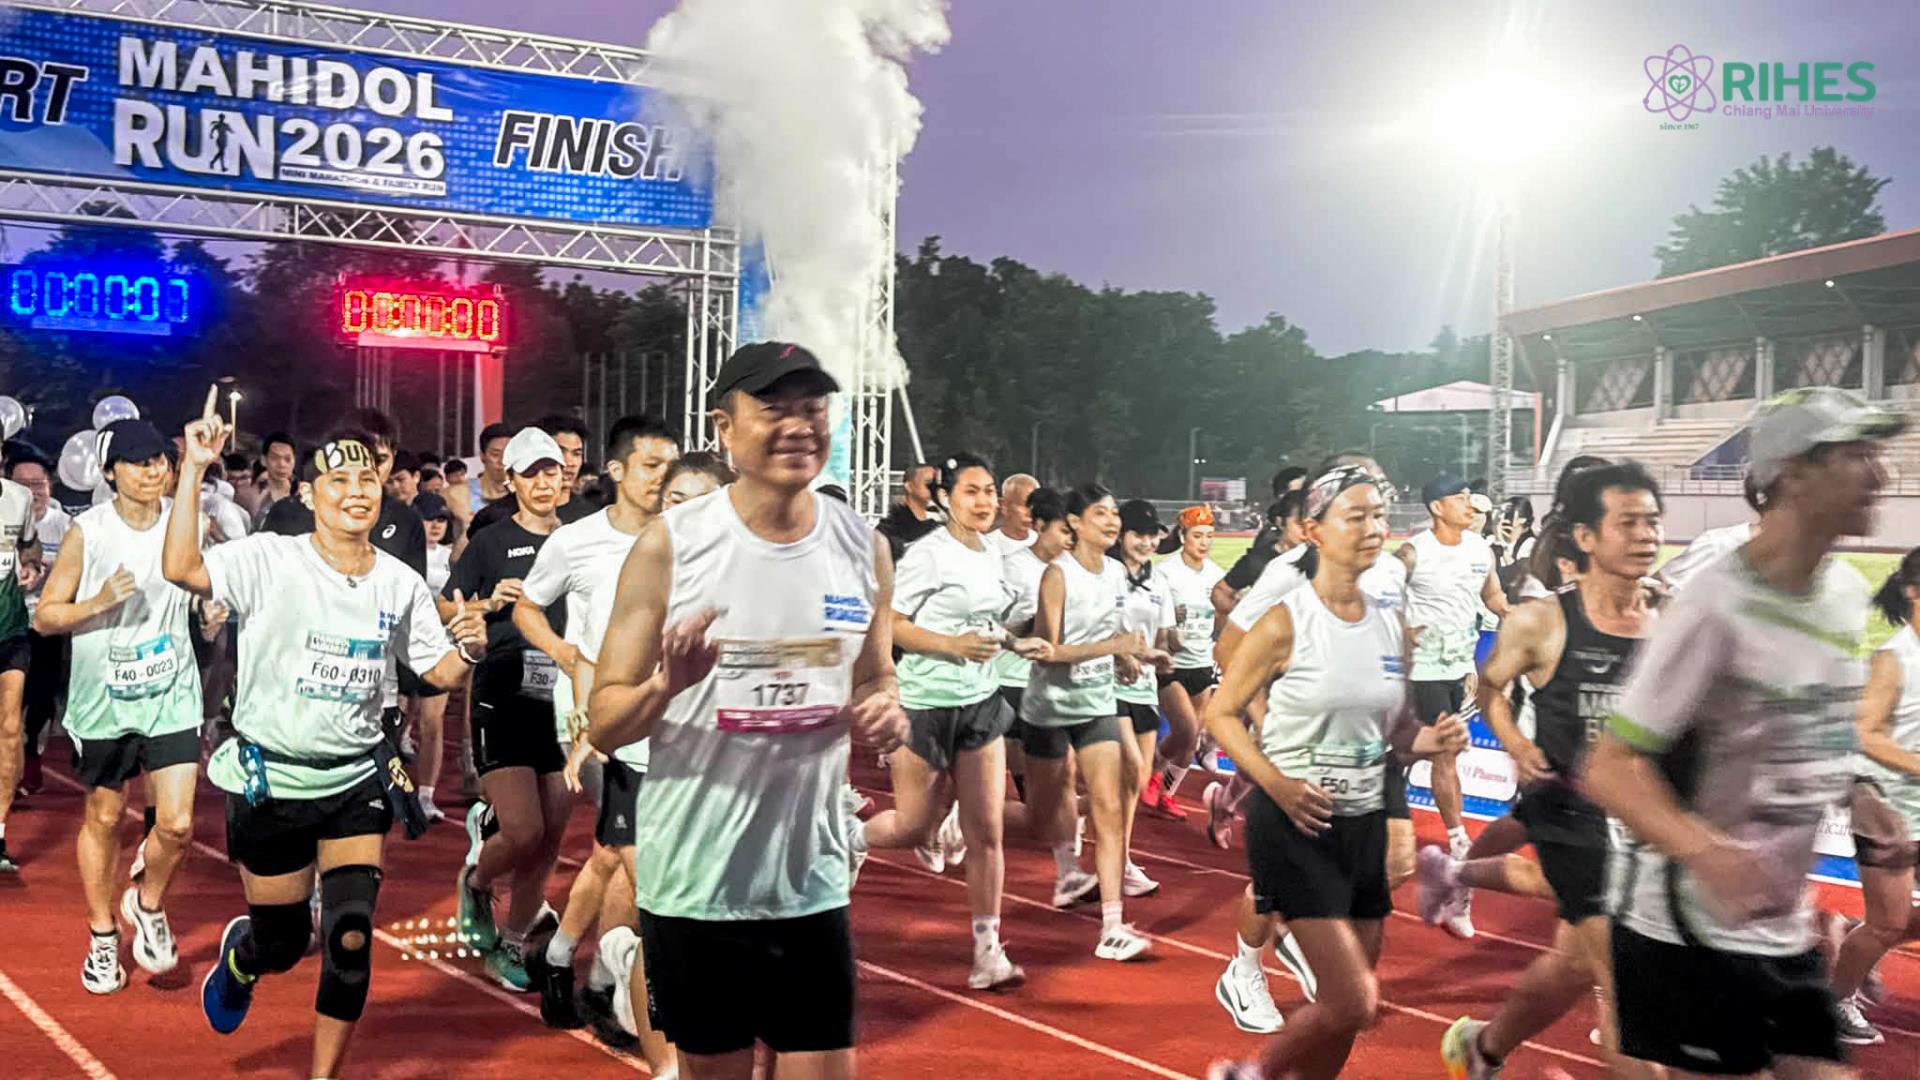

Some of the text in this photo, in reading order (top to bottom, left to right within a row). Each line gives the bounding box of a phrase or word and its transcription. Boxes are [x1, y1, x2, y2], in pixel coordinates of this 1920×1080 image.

[119, 36, 454, 122] MAHIDOL
[113, 98, 446, 181] RUN 2026
[493, 109, 683, 182] FINISH
[344, 290, 499, 341] 00:00:00
[507, 545, 535, 558] HOKA
[751, 683, 810, 706] 1737
